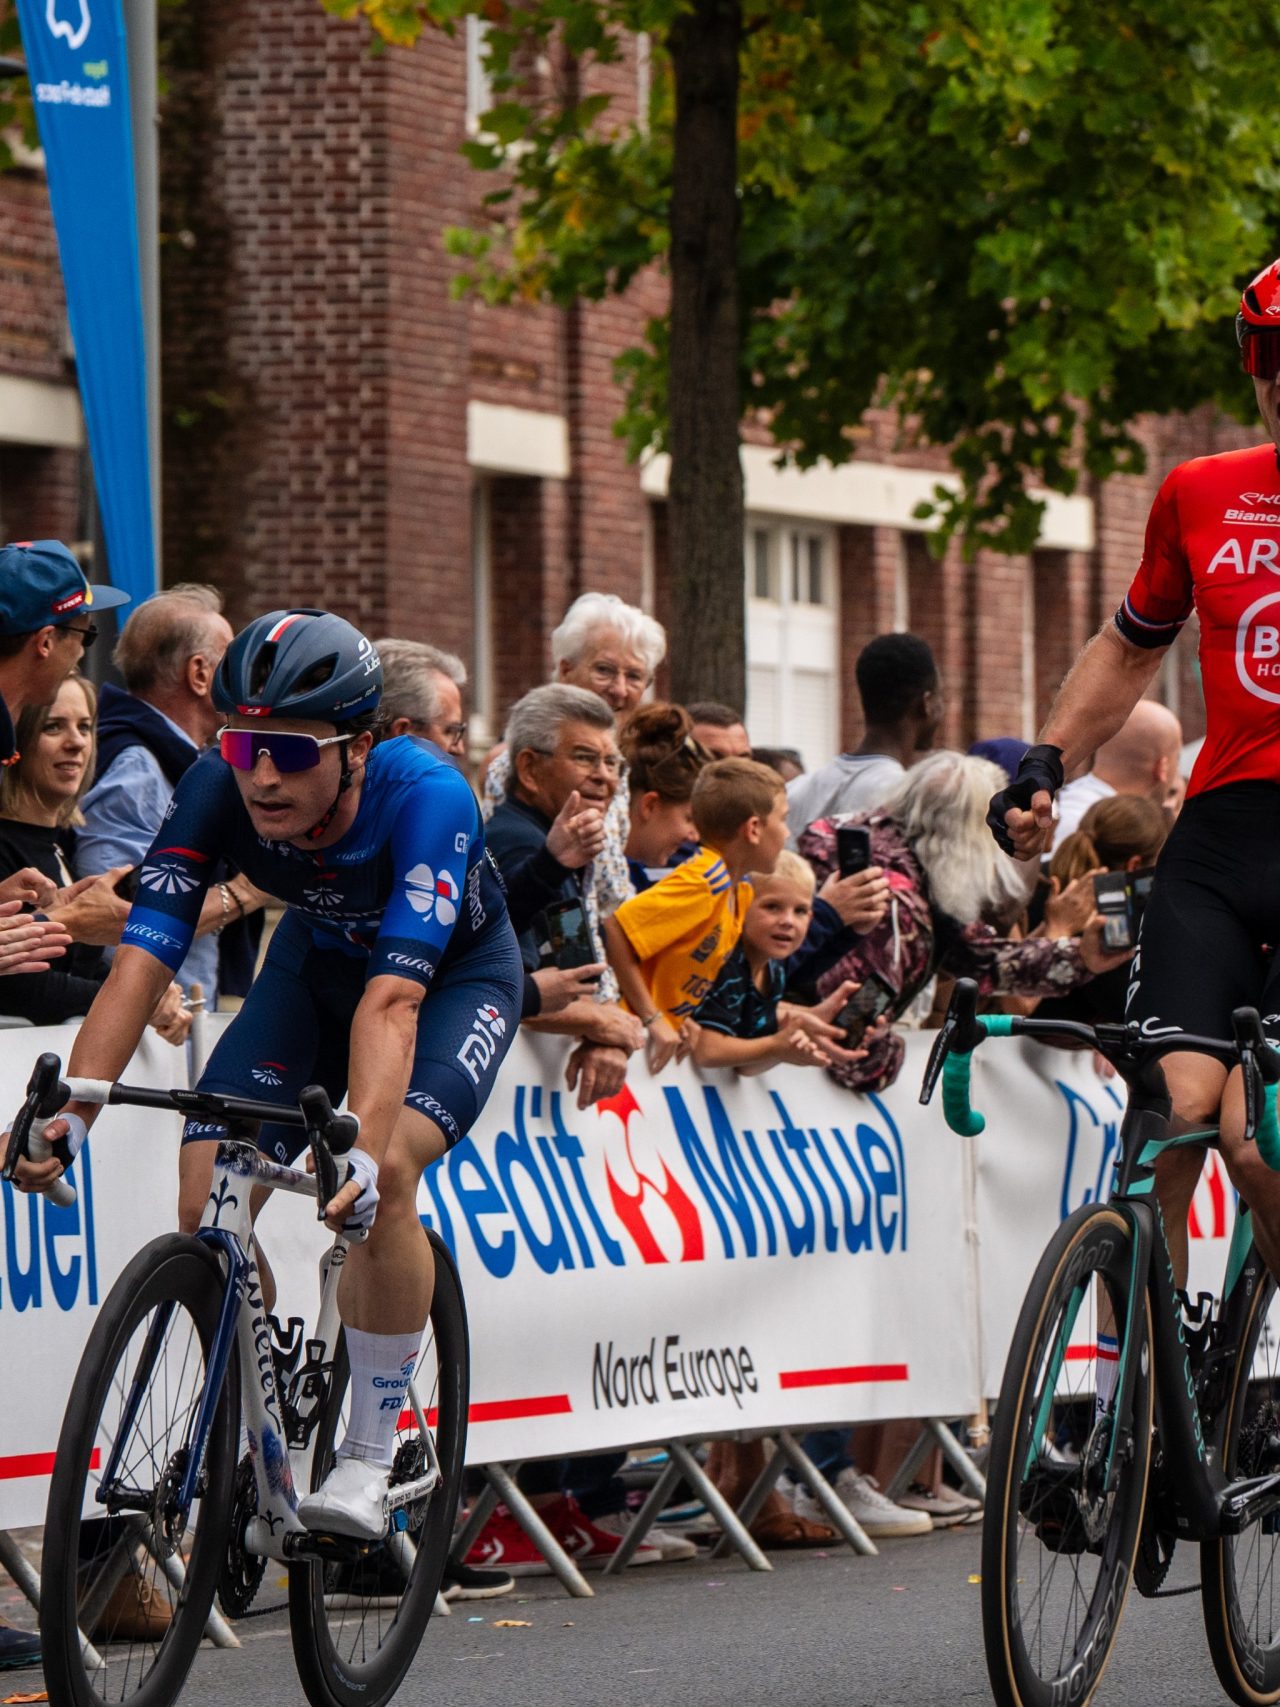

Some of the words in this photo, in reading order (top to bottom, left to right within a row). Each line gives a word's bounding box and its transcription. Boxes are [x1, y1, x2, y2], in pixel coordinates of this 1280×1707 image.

[457, 1019, 496, 1086] FDJ
[0, 1132, 98, 1313] uel
[662, 1085, 908, 1260] Mutuel
[592, 1337, 659, 1411] Nord
[664, 1334, 759, 1411] Europe
